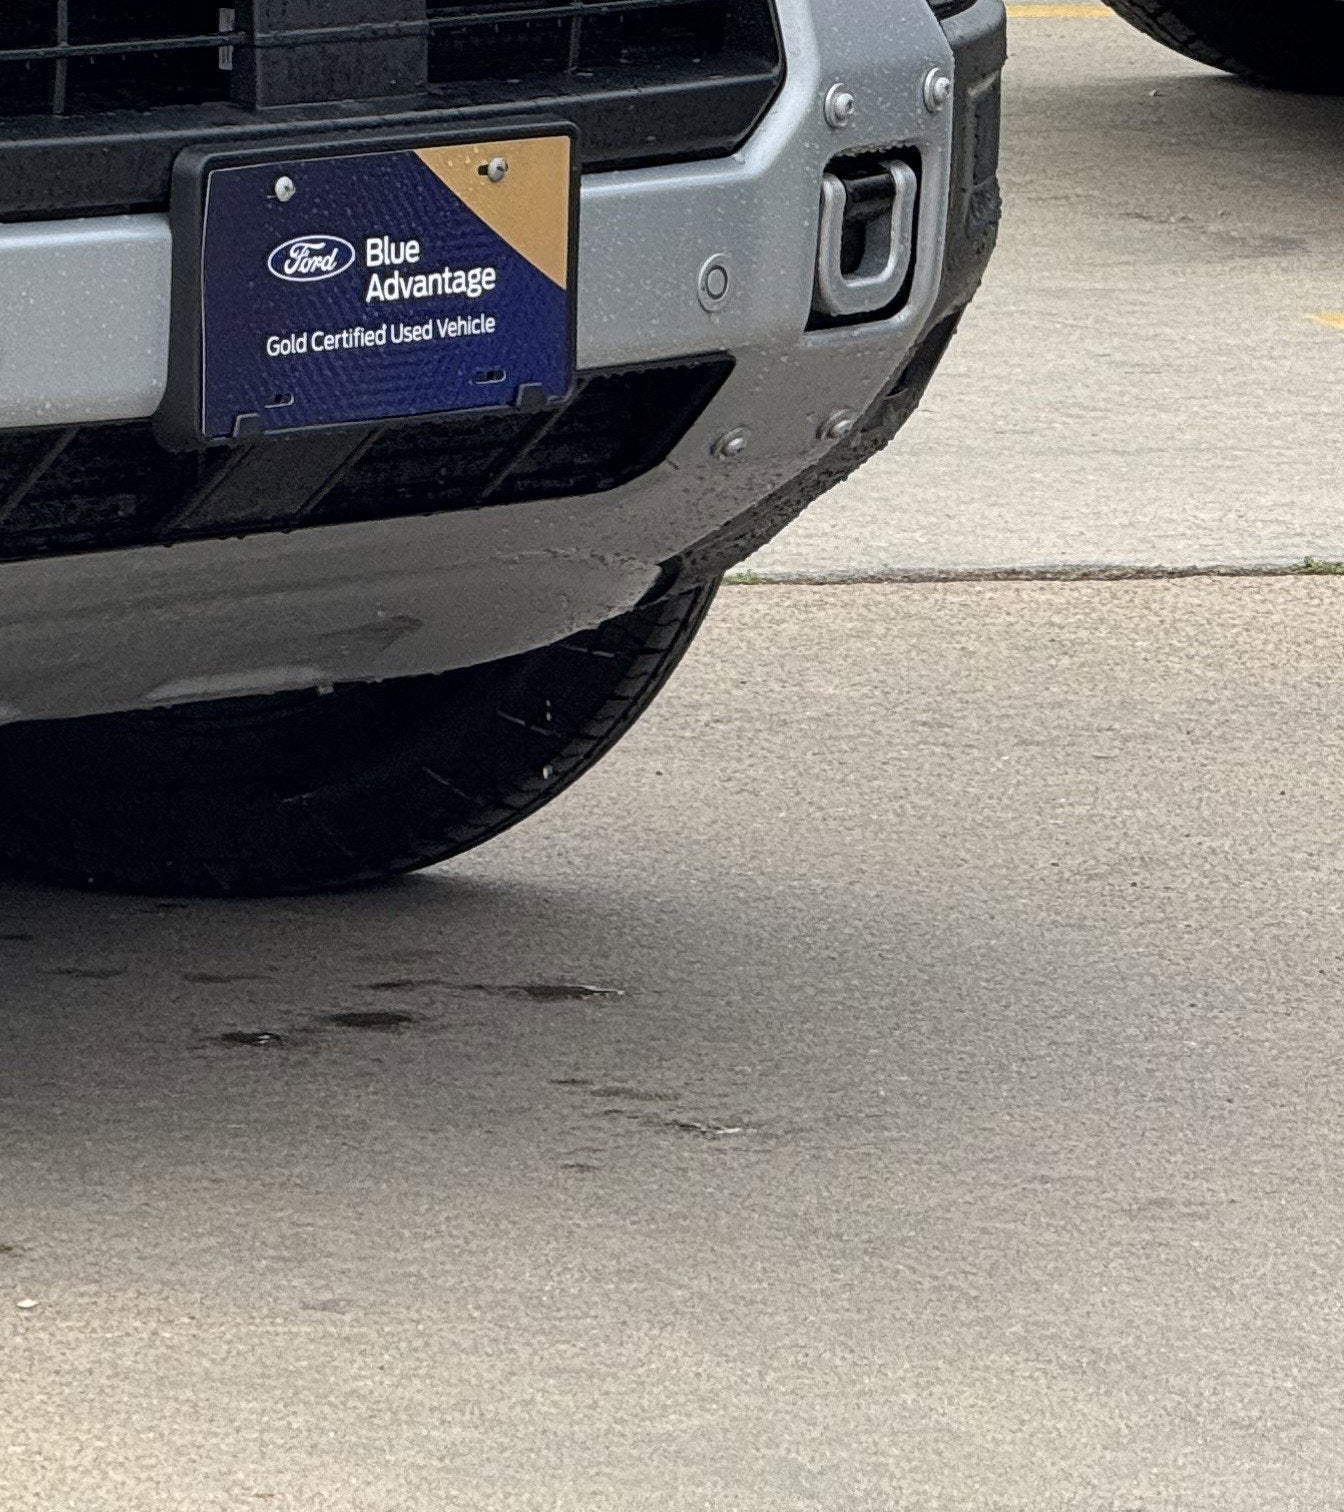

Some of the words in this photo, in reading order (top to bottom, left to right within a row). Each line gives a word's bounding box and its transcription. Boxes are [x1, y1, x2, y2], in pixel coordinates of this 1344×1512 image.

[282, 242, 338, 276] Ford
[365, 236, 420, 267] Blue
[365, 266, 496, 303] Advantage
[266, 330, 309, 358] Gold
[311, 324, 387, 353] Certified
[391, 319, 434, 345] Used
[436, 313, 496, 340] Vehicle
